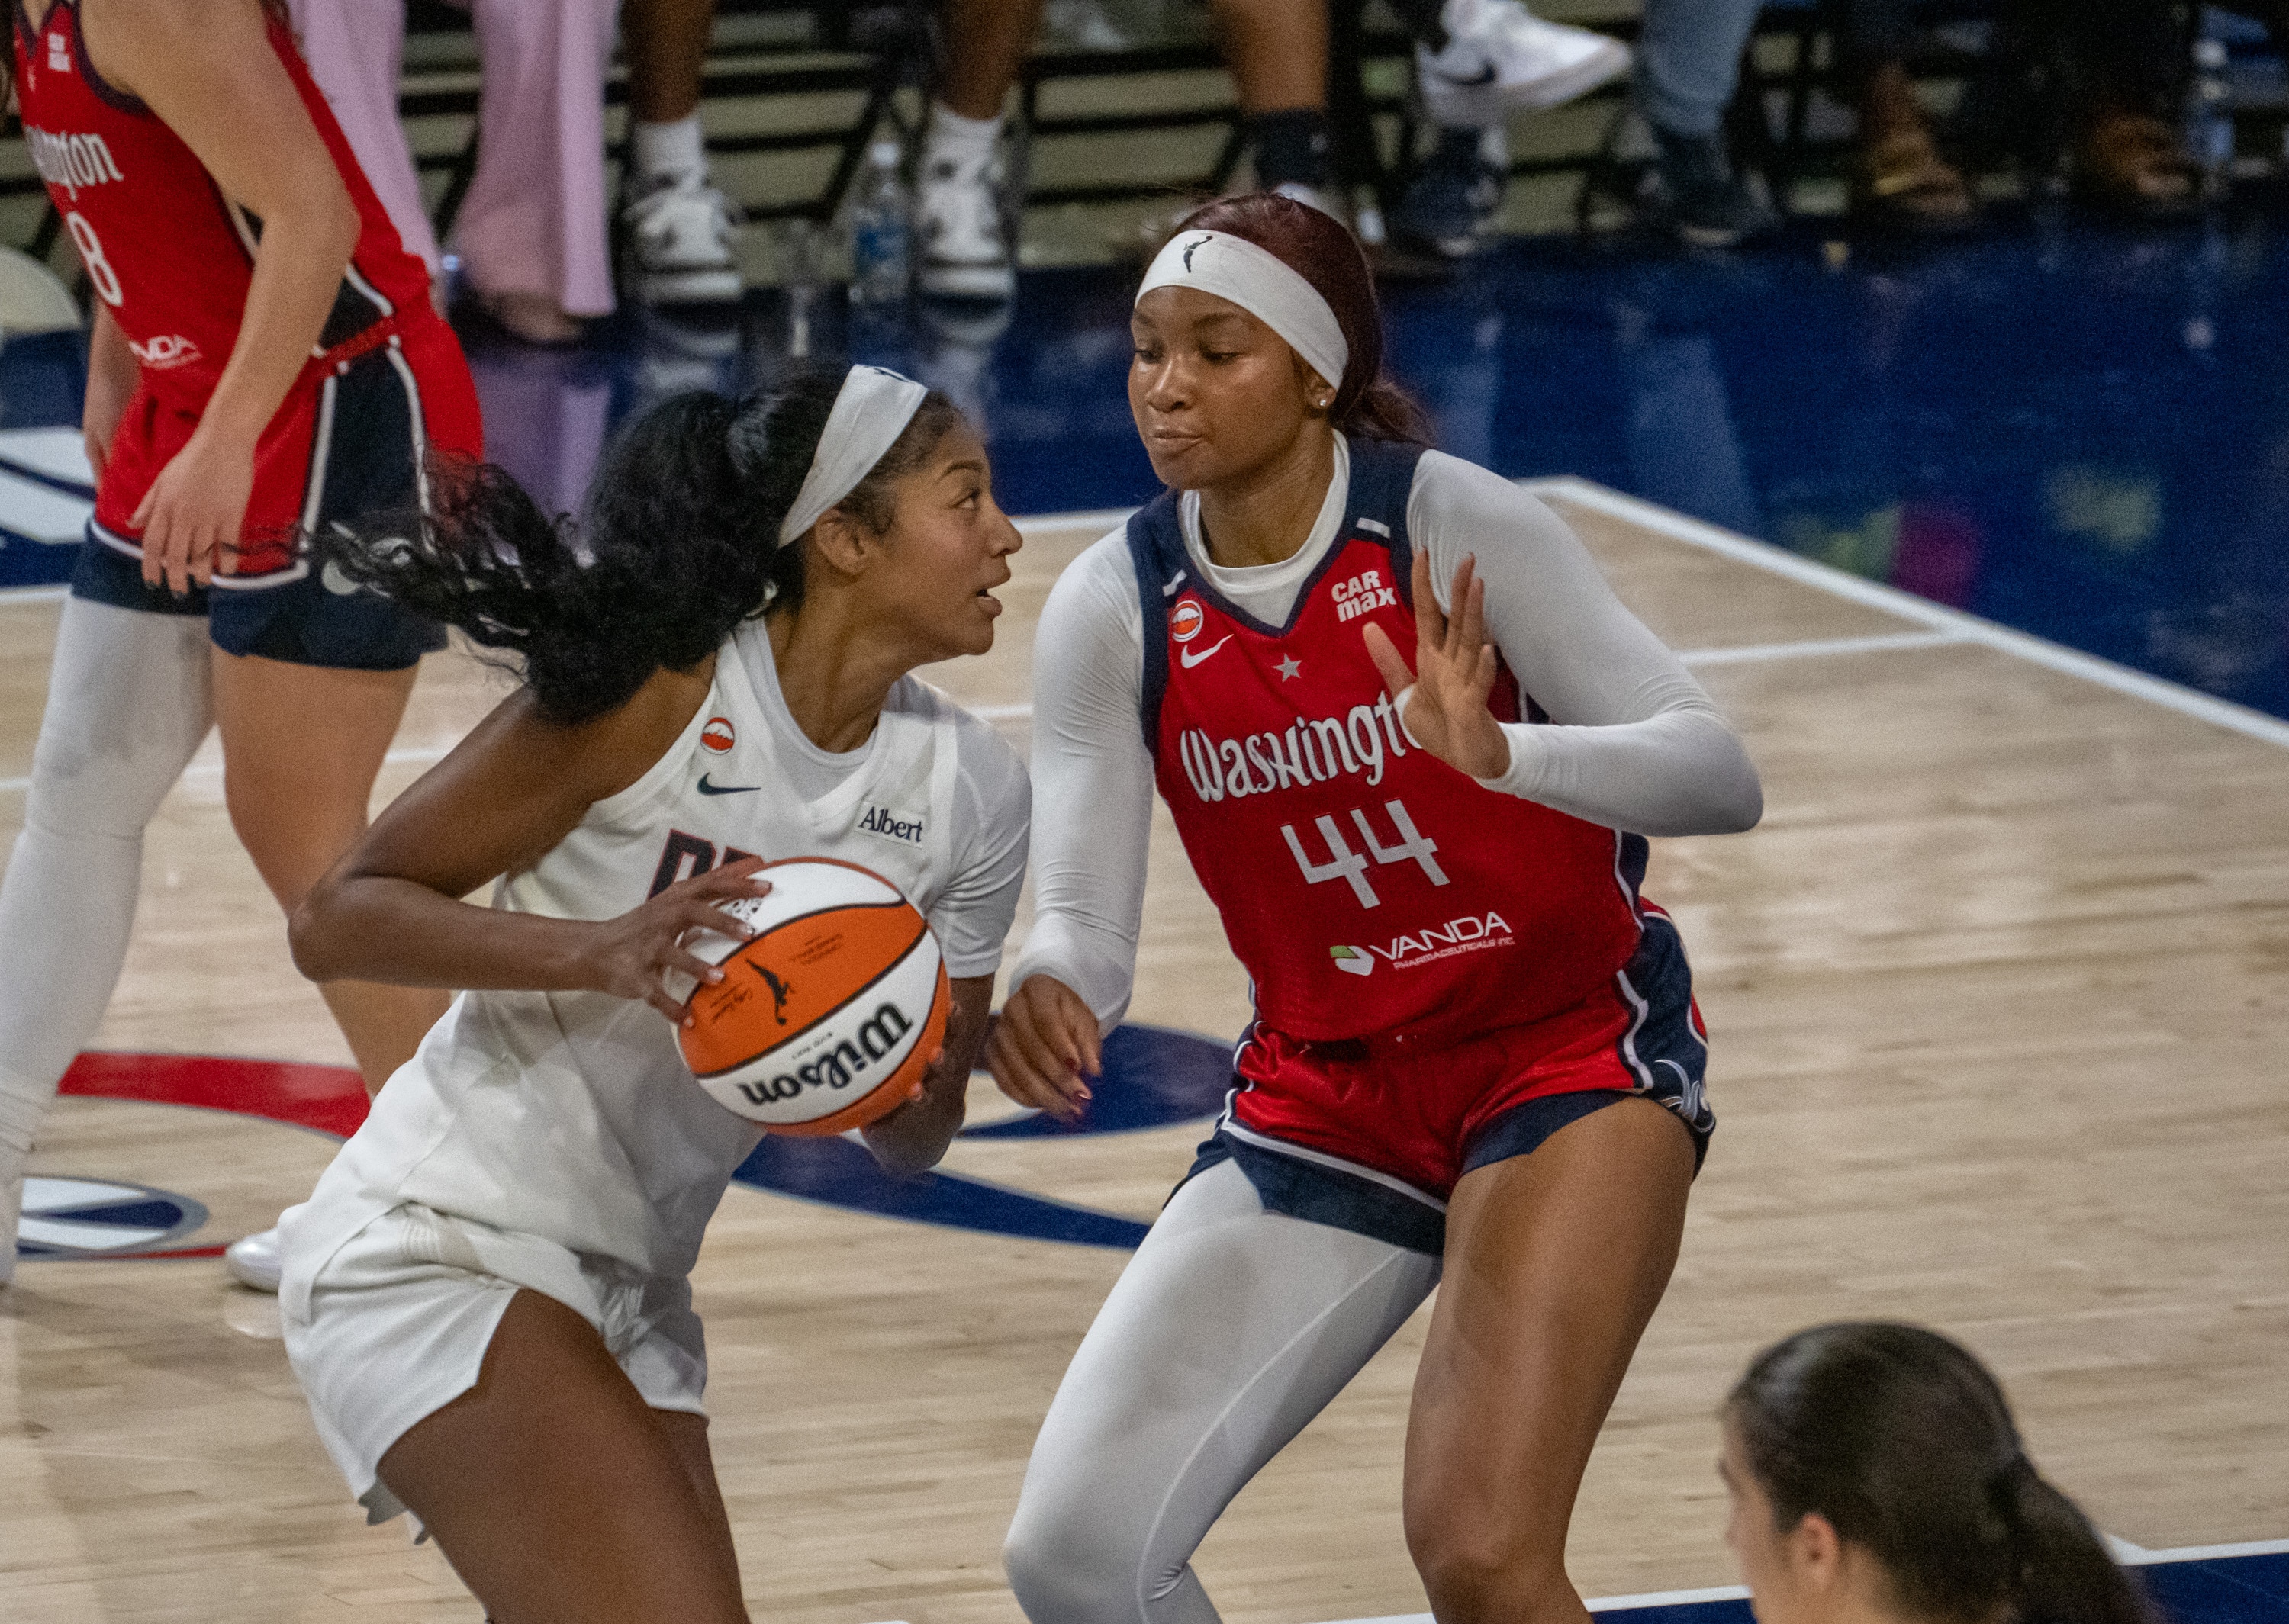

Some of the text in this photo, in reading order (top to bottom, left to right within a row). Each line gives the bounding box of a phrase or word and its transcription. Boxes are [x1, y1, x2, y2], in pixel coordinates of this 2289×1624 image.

[66, 210, 124, 307] 8
[1331, 570, 1381, 603] CAR
[1336, 587, 1397, 622] max
[857, 806, 923, 843] Albert
[1280, 799, 1450, 909] 44
[1369, 912, 1512, 960] VANDA
[736, 1002, 914, 1105] Wilson
